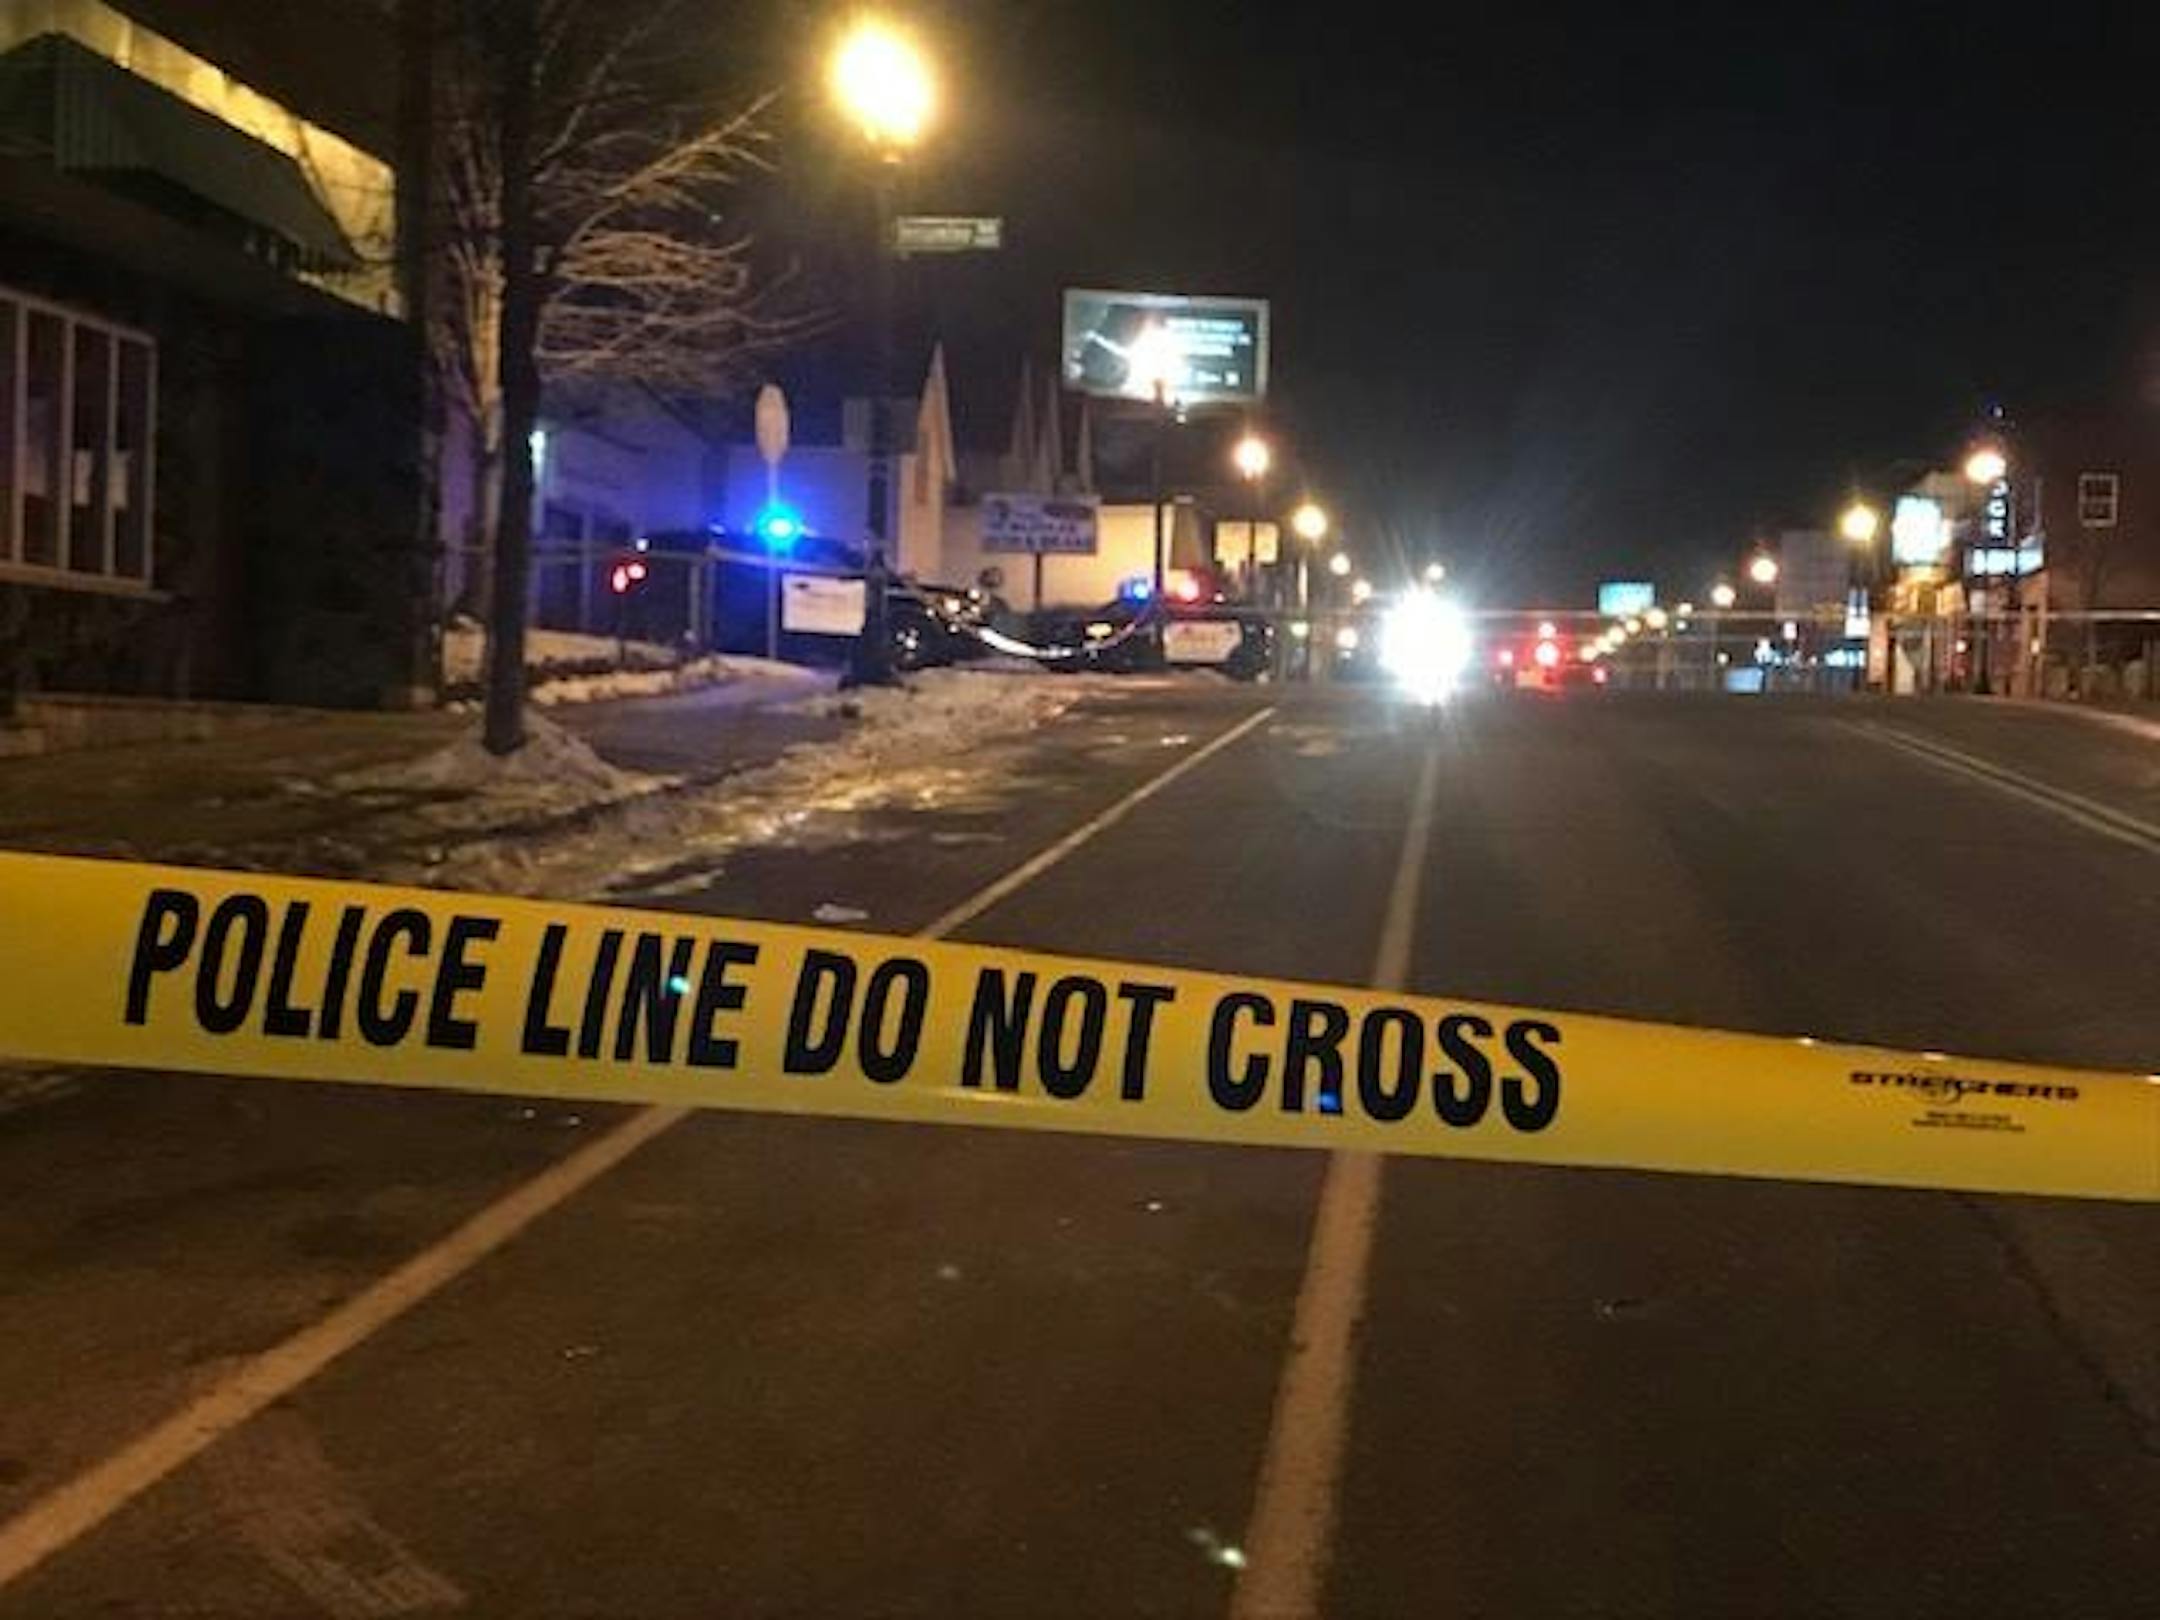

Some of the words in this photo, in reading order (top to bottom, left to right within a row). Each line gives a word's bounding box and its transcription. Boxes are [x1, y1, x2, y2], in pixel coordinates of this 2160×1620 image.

[122, 888, 502, 1052] POLICE
[519, 924, 760, 1070] LINE
[782, 948, 930, 1085] DO
[960, 967, 1177, 1103] NOT
[1207, 992, 1561, 1134] CROSS
